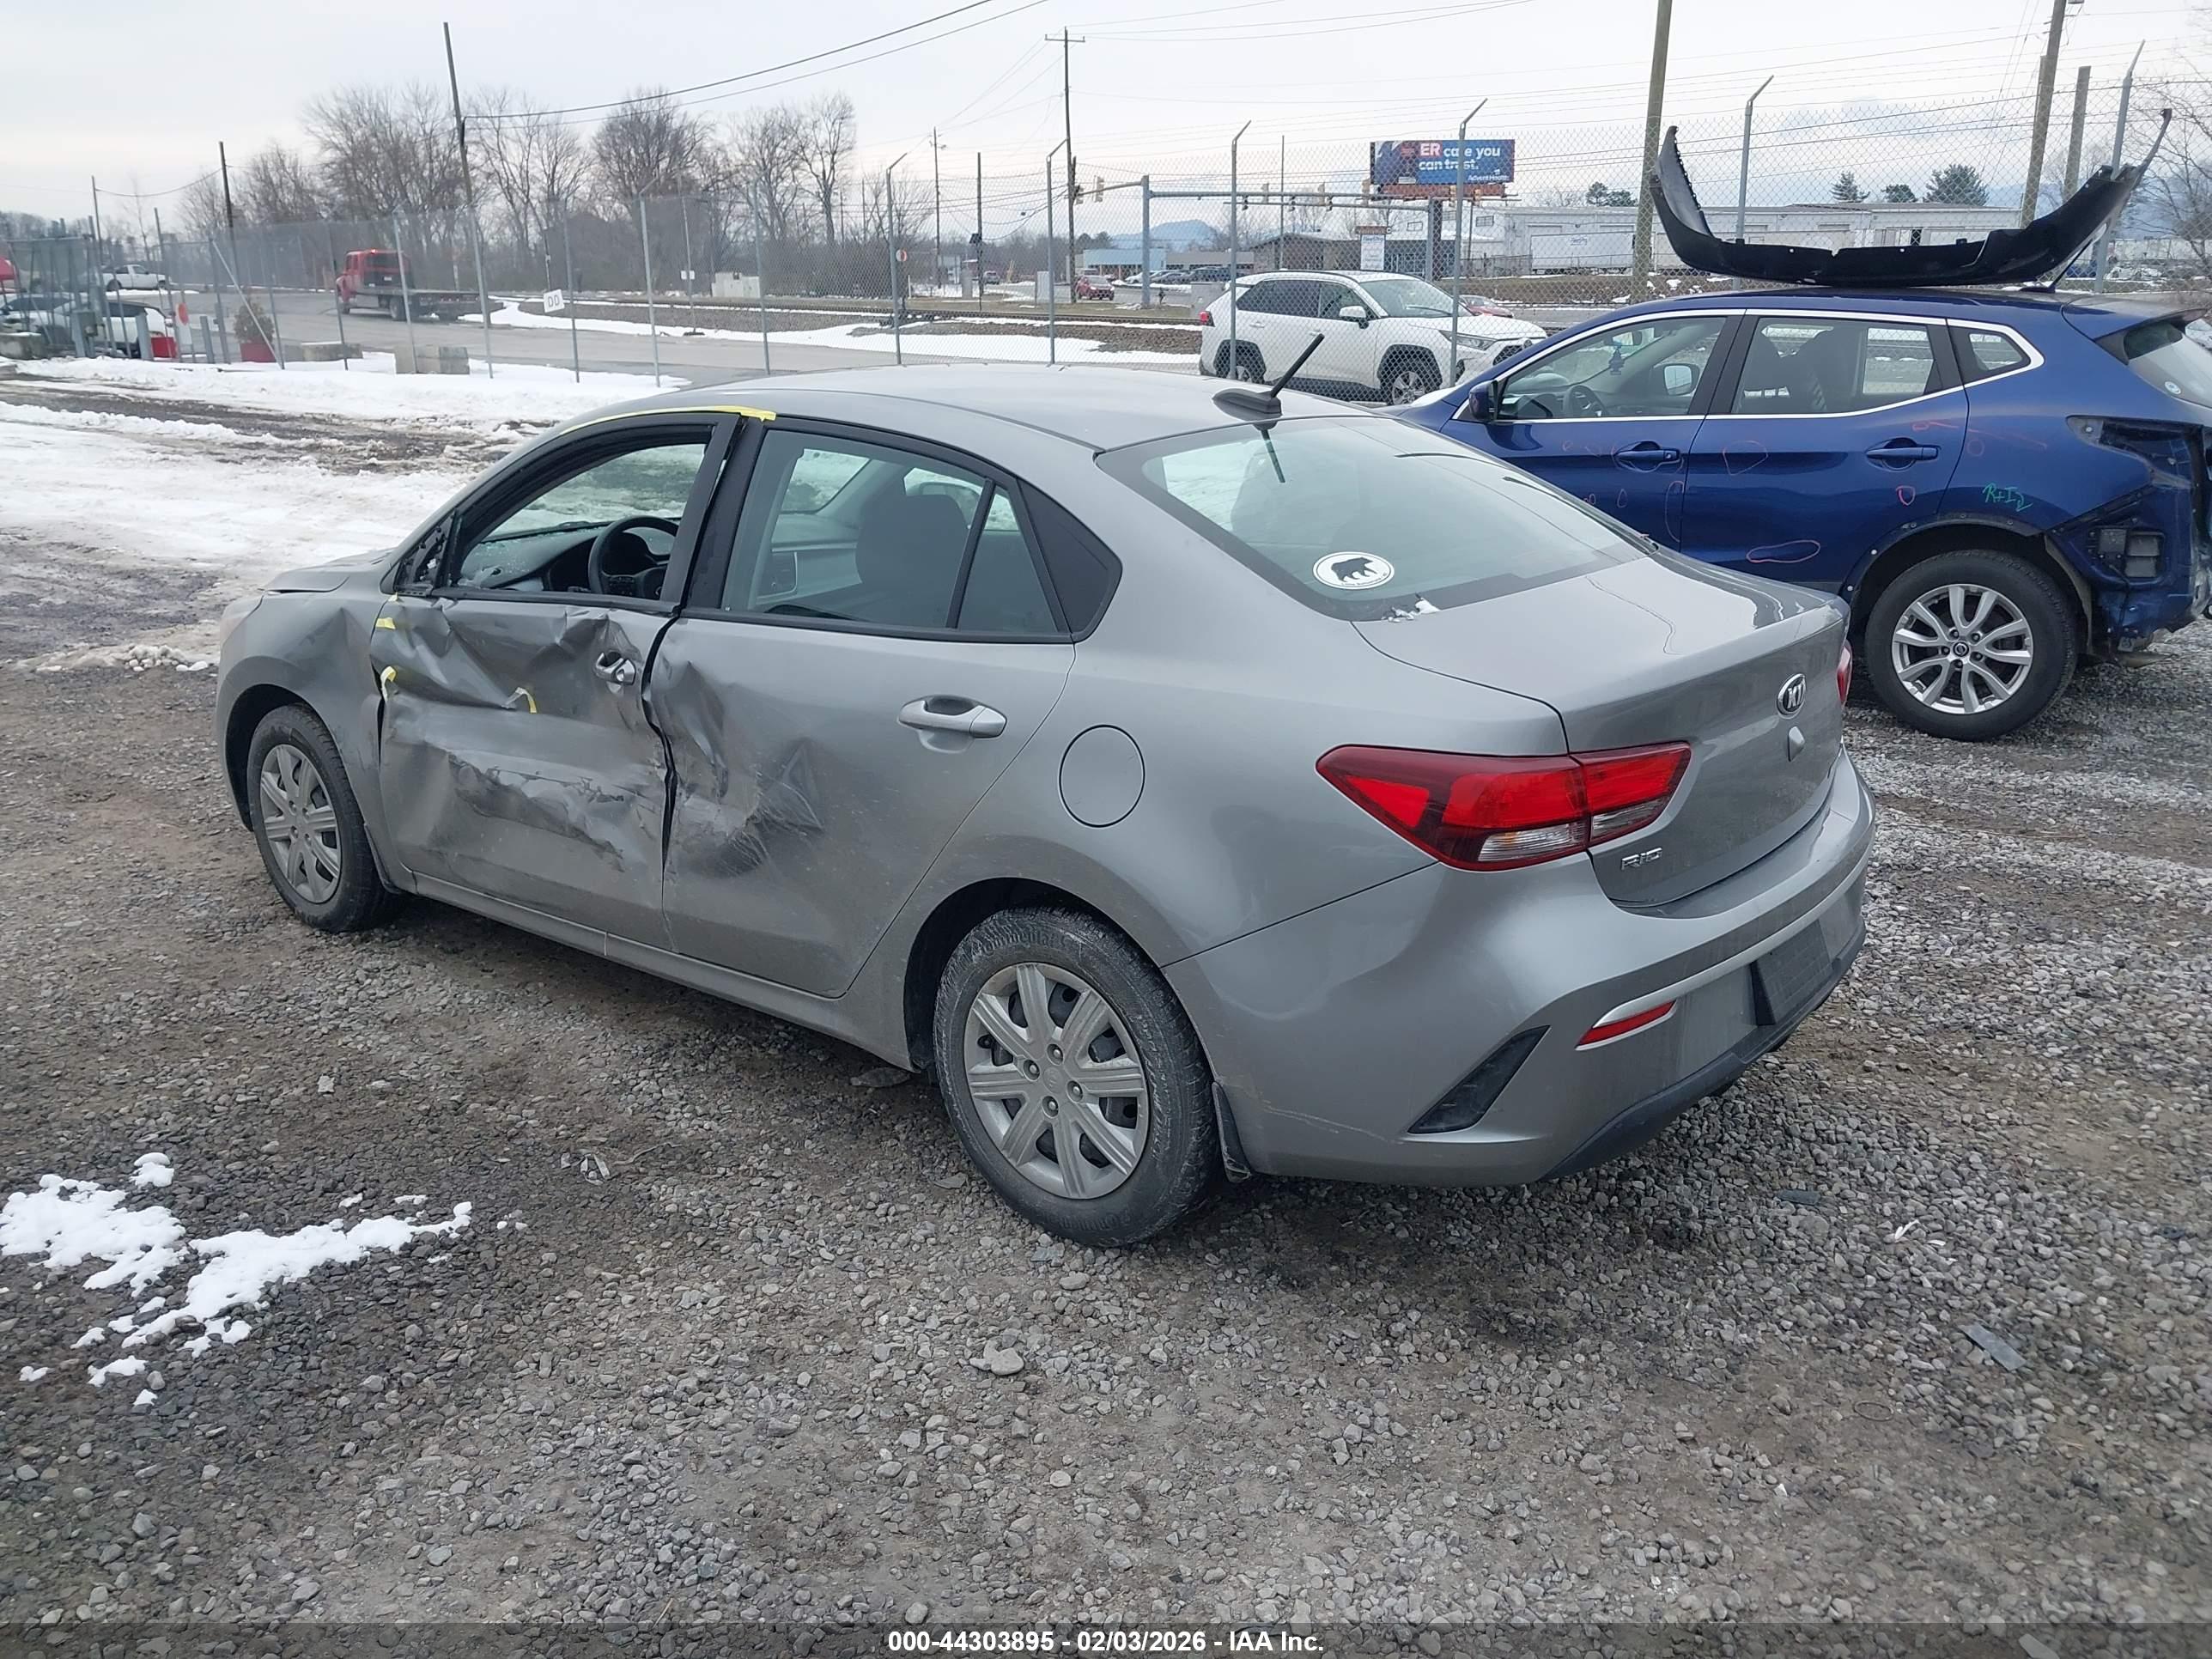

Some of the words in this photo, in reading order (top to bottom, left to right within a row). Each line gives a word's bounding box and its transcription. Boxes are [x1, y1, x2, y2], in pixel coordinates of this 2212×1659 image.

[1419, 143, 1441, 156] ER
[1443, 146, 1473, 157] cae
[1475, 147, 1501, 160] you
[1418, 159, 1443, 171] can
[1443, 158, 1480, 170] trst.
[1621, 847, 1663, 871] RIO
